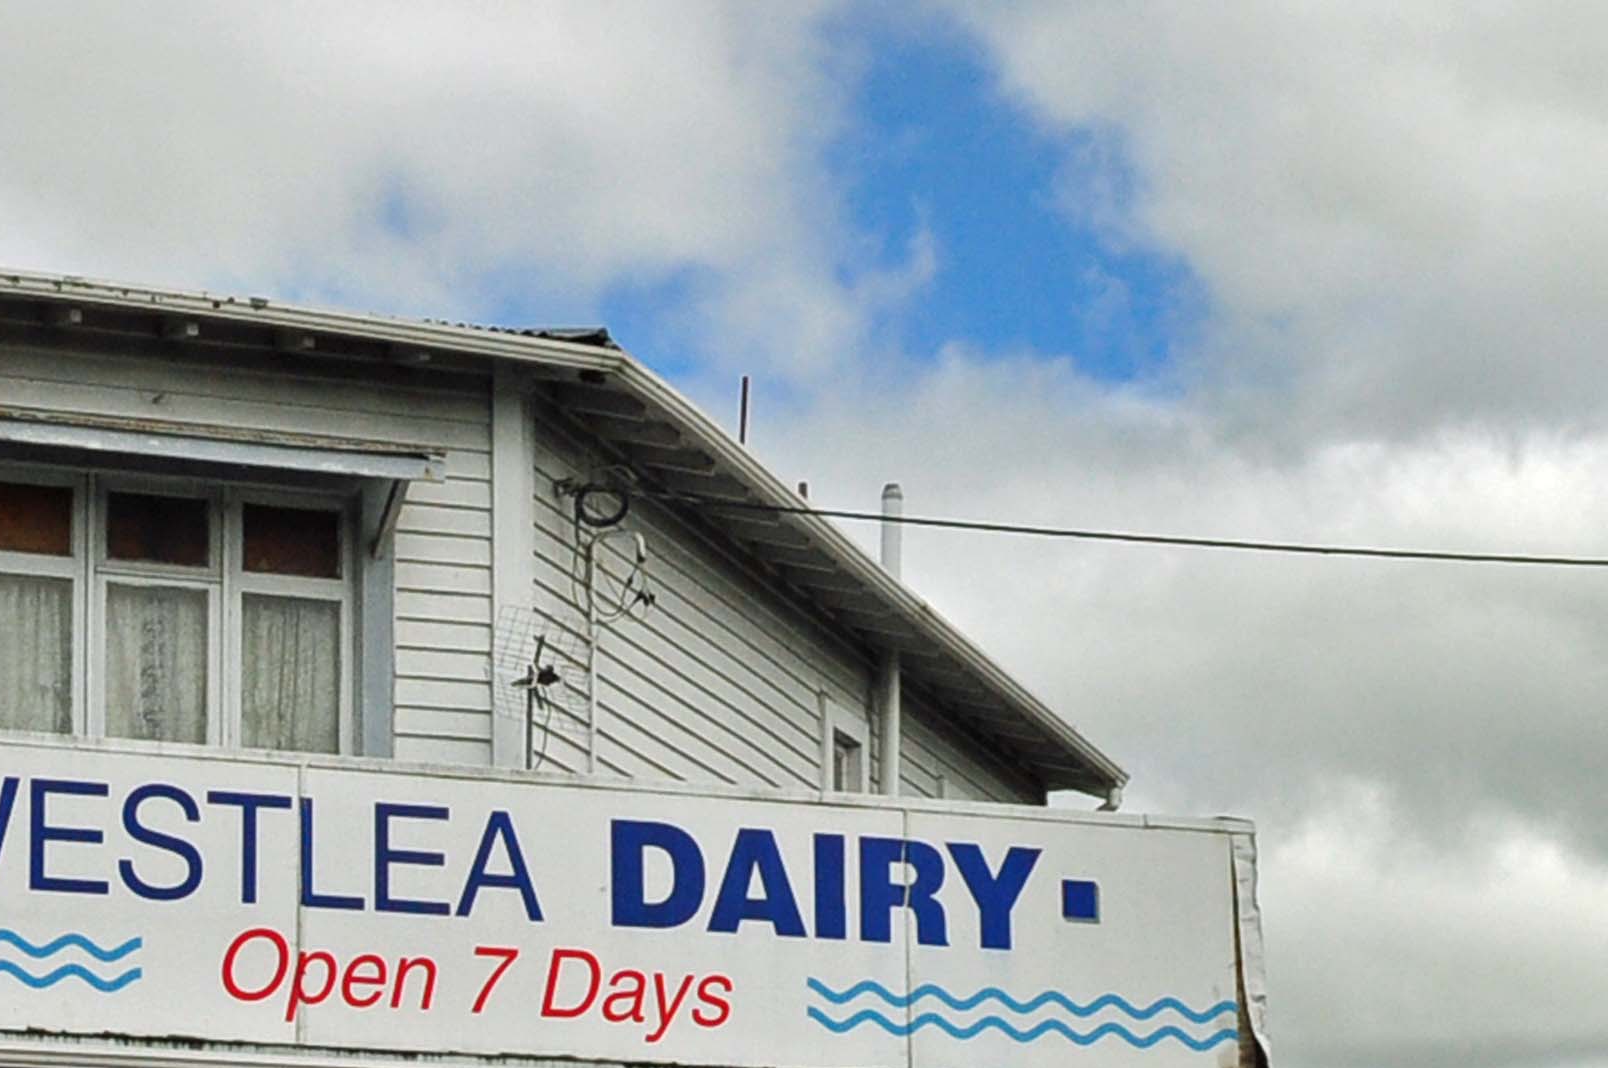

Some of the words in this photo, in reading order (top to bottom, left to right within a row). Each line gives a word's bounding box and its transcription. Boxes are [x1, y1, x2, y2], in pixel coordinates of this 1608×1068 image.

[610, 817, 1043, 951] DAIRY
[221, 927, 437, 1023] Open
[471, 947, 519, 1015] 7
[540, 948, 734, 1043] Days
